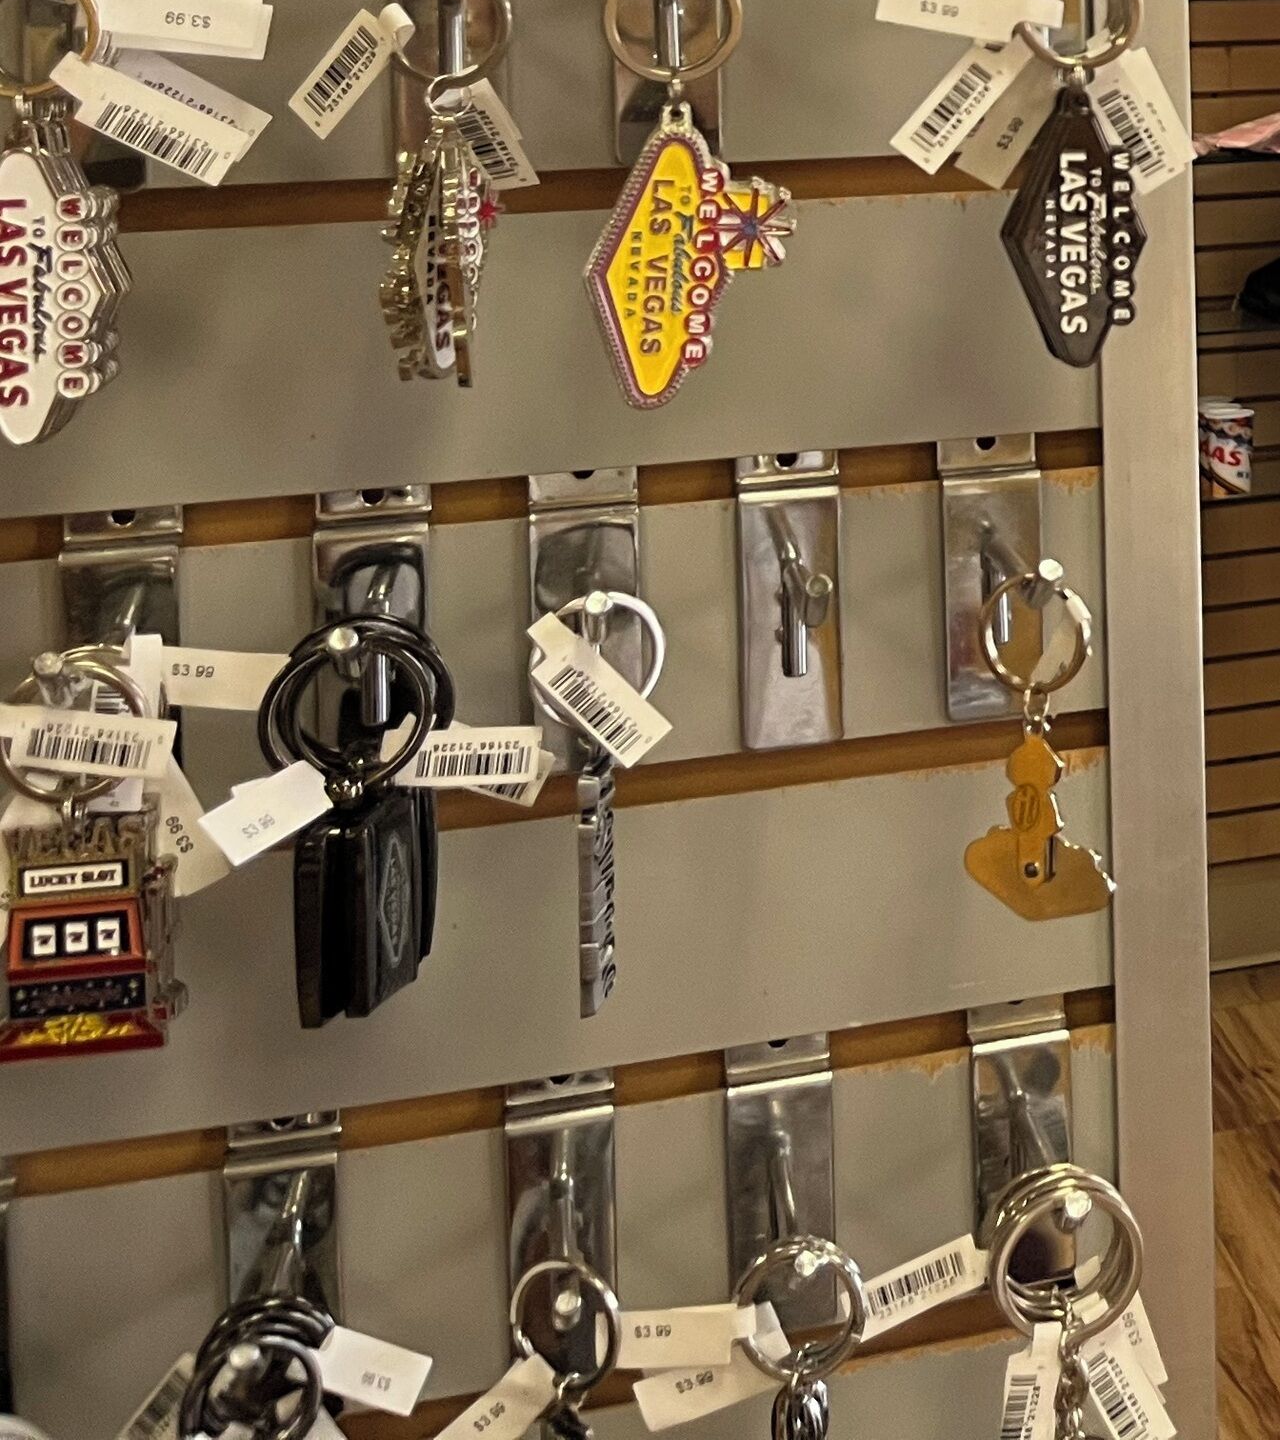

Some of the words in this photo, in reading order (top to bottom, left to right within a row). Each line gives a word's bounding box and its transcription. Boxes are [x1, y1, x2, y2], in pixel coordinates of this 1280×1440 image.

[649, 179, 676, 237] LAS
[679, 184, 694, 208] TO
[1059, 151, 1088, 214] LAS
[1089, 167, 1103, 188] TO
[32, 216, 46, 239] TO
[684, 169, 722, 361] WELCOME
[1044, 198, 1058, 279] NEVADA
[1111, 151, 1132, 321] WELCOME
[27, 242, 53, 364] Fabulous
[60, 197, 85, 392] WELCOME
[624, 230, 644, 320] NEVADA
[639, 252, 670, 357] VEGAS
[1060, 220, 1089, 336] VEGAS
[0, 277, 30, 408] VEGAS
[30, 870, 77, 888] LUCKY
[81, 868, 117, 884] SLOT
